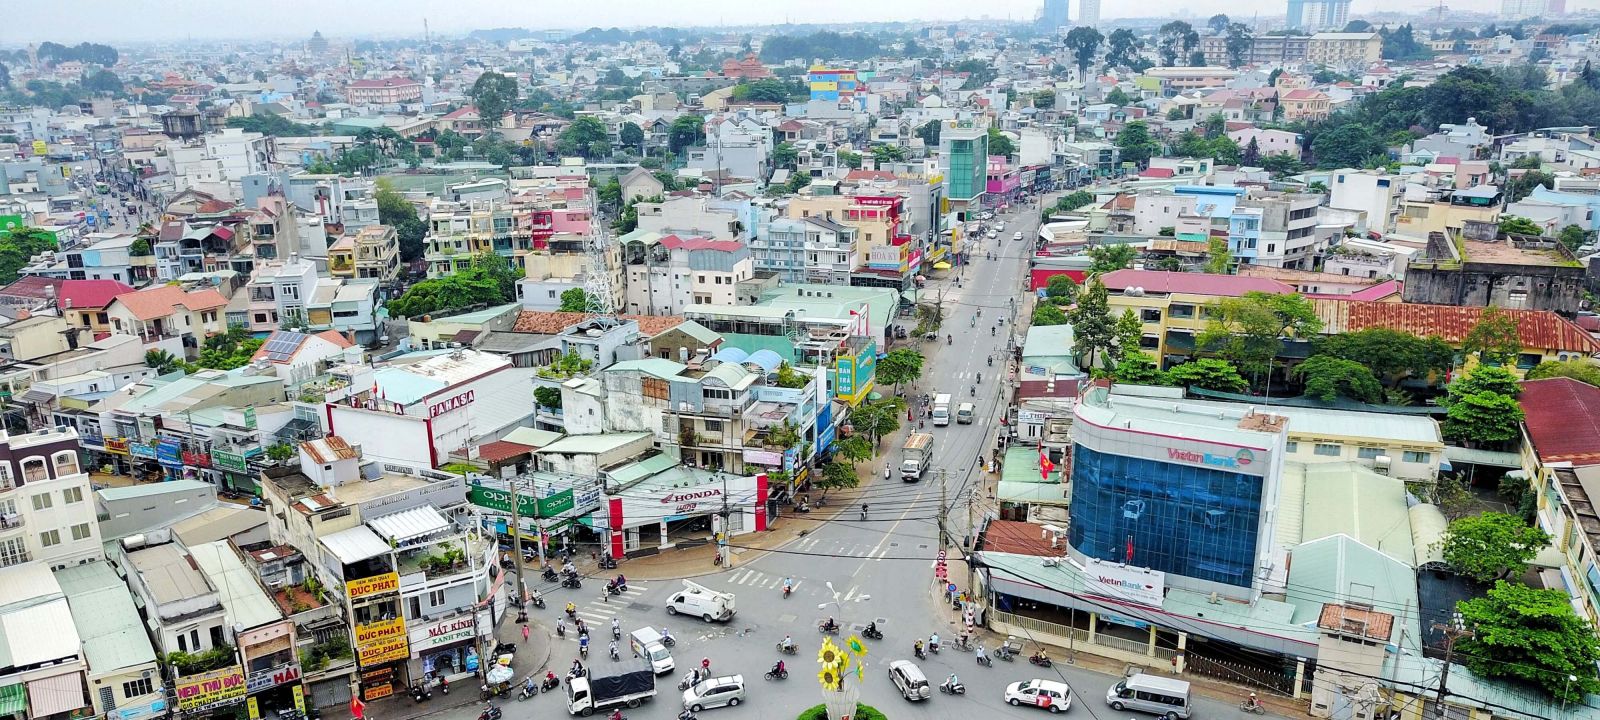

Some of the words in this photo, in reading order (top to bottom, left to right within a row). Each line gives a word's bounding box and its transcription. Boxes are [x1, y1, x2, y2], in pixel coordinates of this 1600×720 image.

[430, 389, 475, 418] FAHASA
[1168, 447, 1236, 468] VietinBank
[675, 489, 722, 502] HONDA
[1098, 575, 1143, 591] VietinBank
[432, 634, 454, 645] XANH
[273, 667, 299, 685] HẢI
[177, 684, 200, 699] NEM
